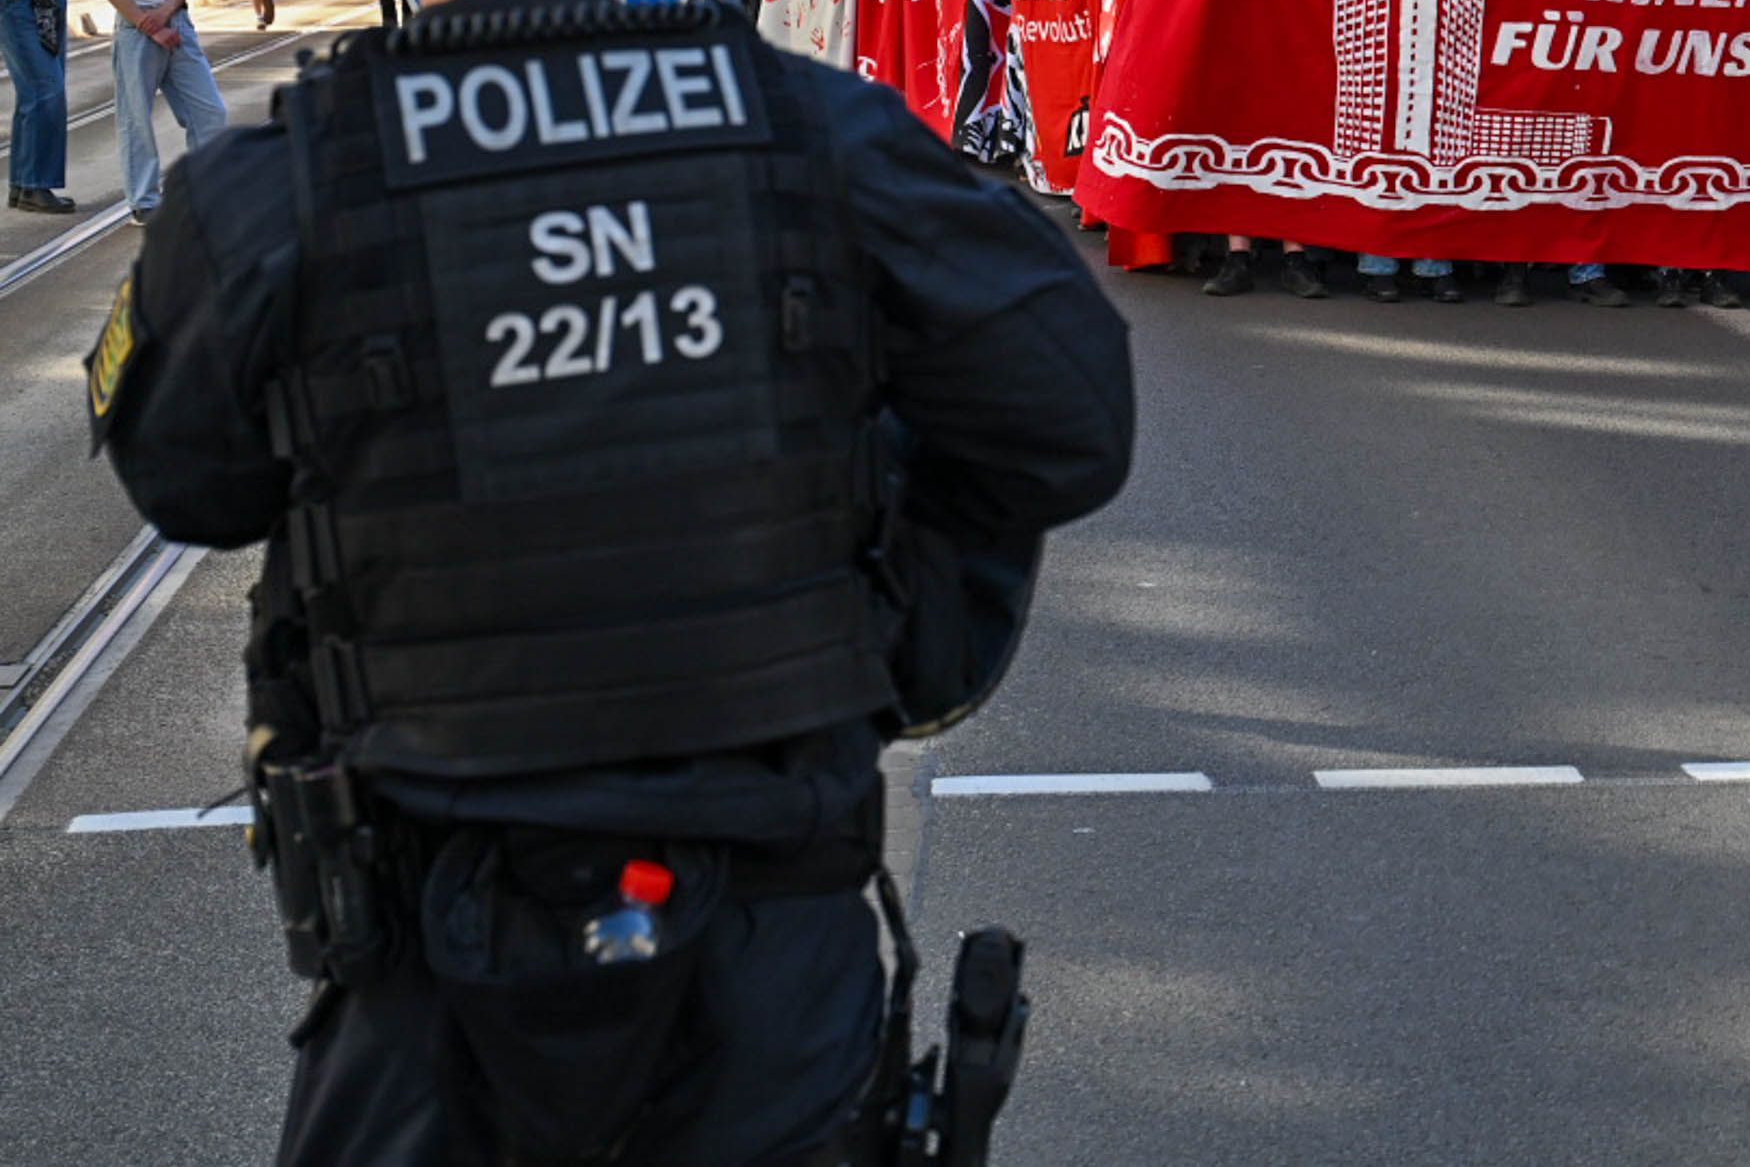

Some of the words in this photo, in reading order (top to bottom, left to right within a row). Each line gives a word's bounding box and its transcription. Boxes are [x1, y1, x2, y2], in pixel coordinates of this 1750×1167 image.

[1491, 10, 1623, 72] FÜR
[397, 44, 748, 164] POLIZEI
[529, 200, 656, 286] SN
[484, 284, 724, 389] 22/13
